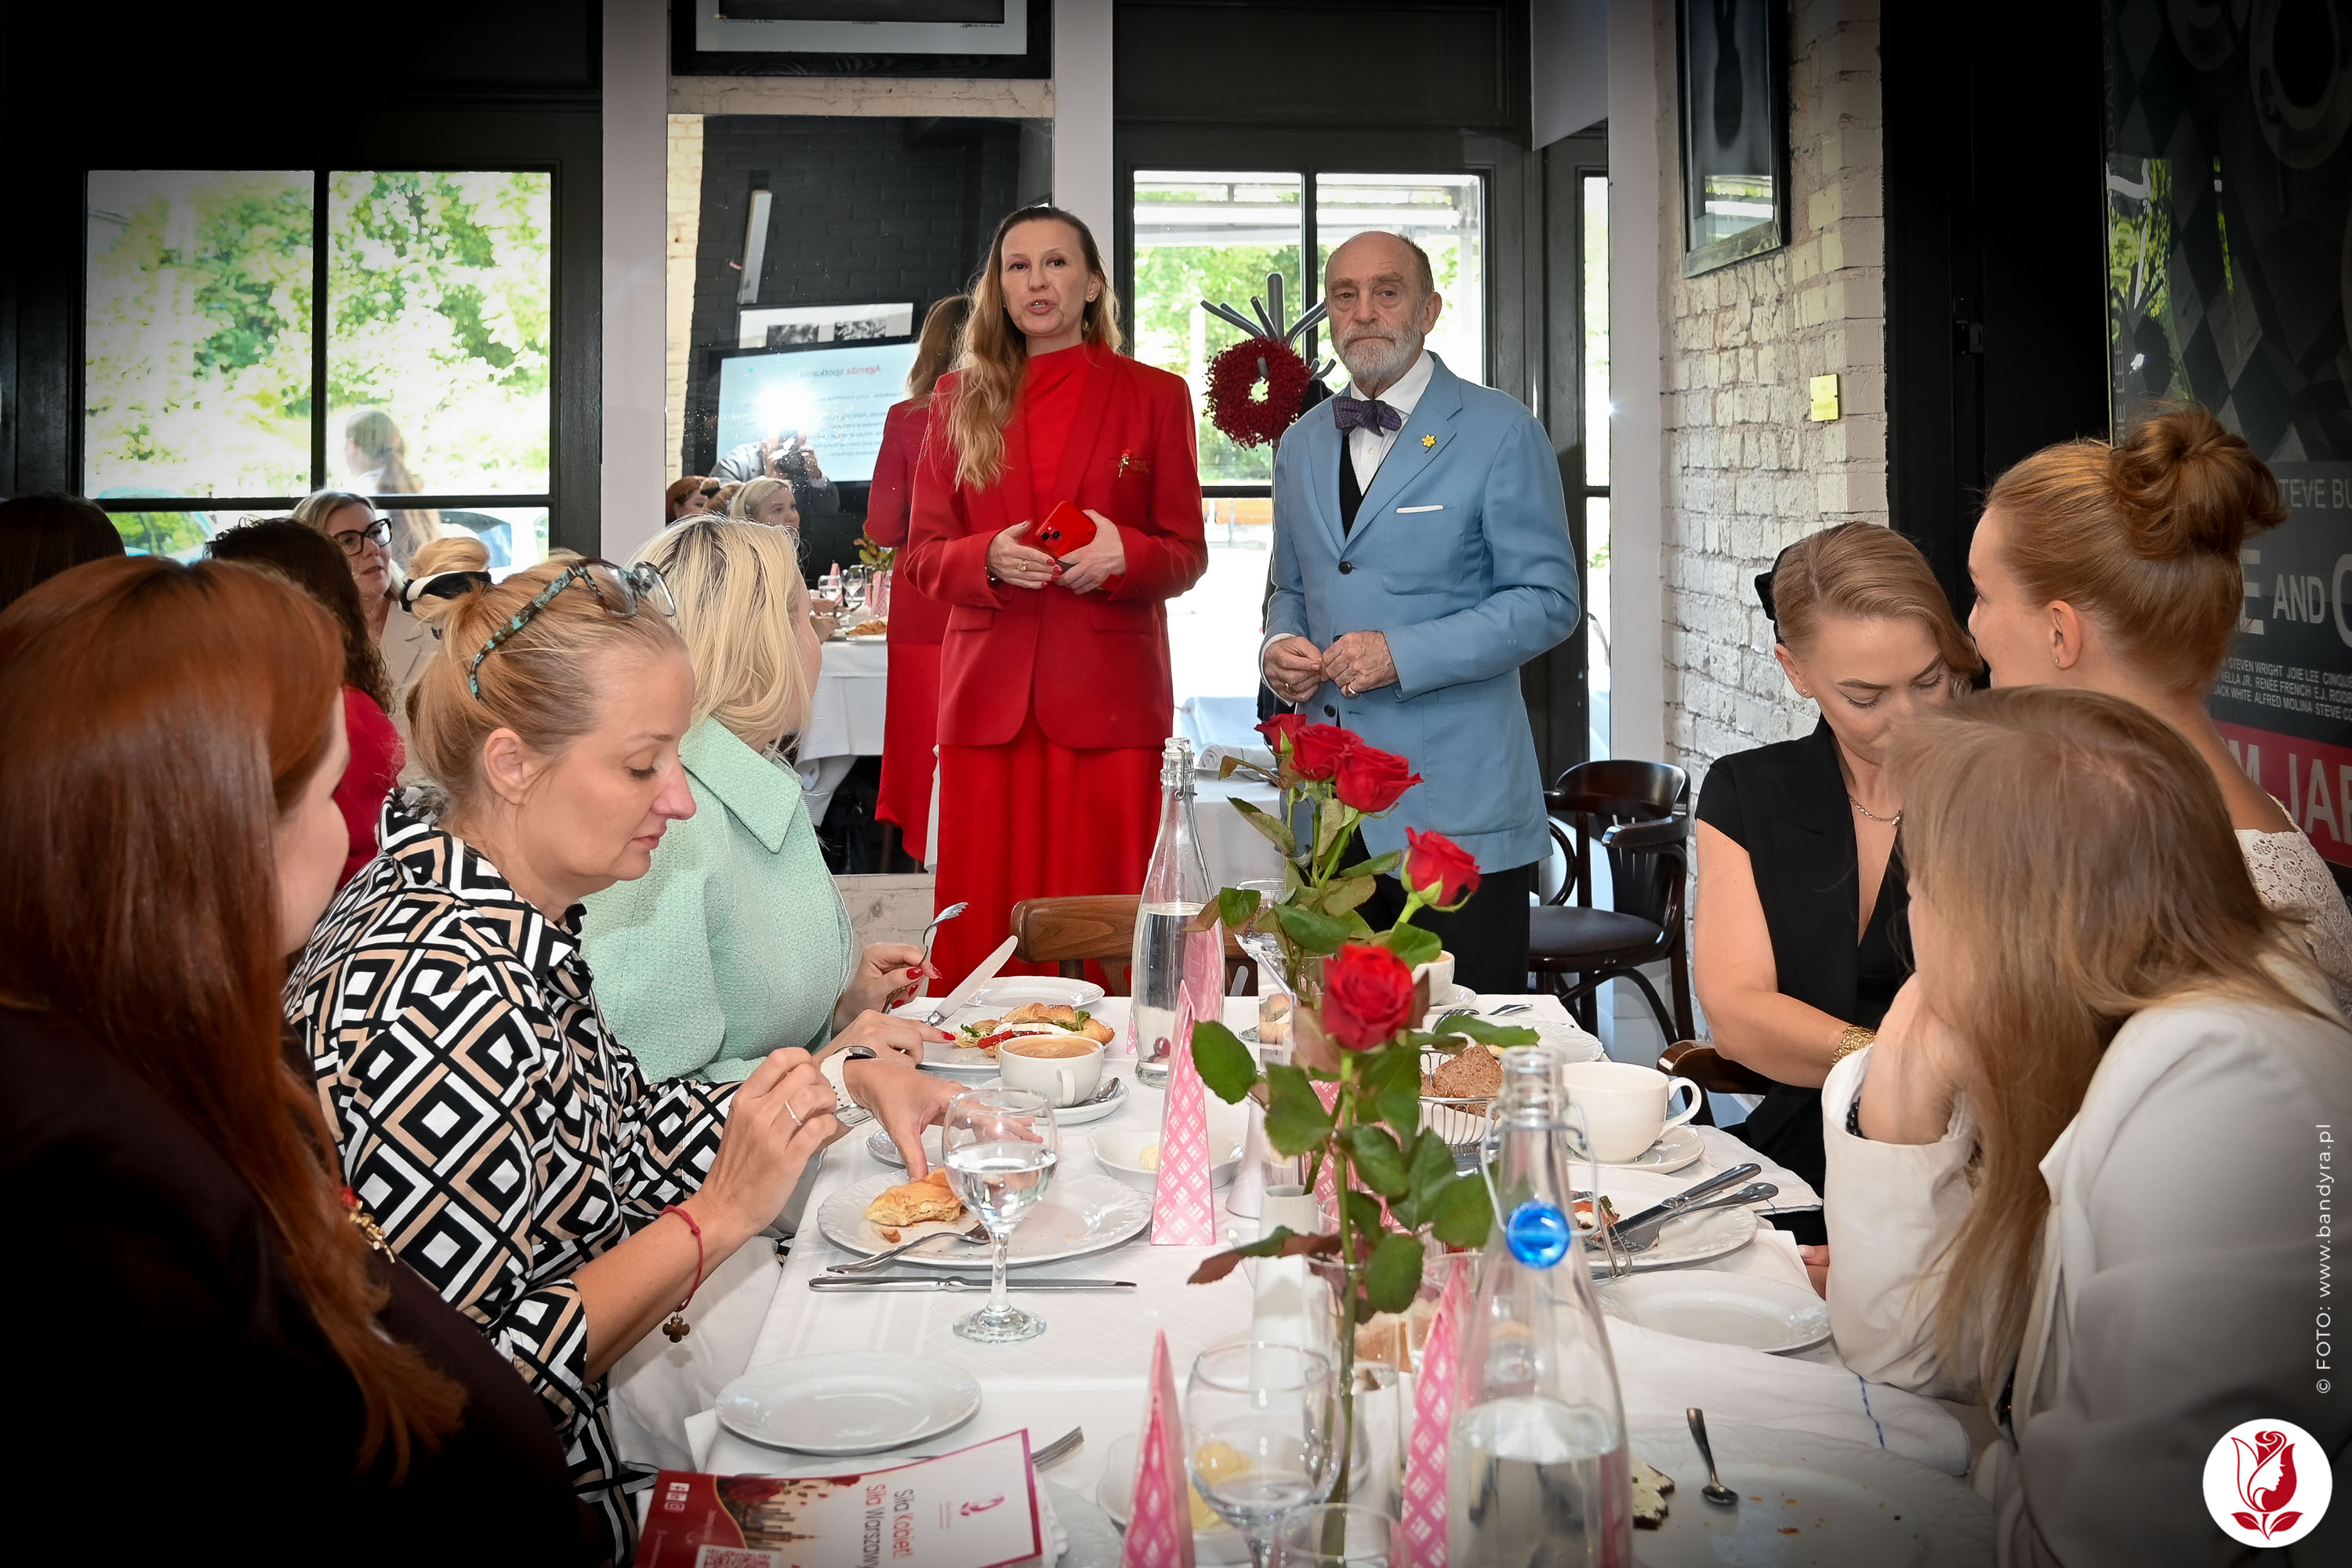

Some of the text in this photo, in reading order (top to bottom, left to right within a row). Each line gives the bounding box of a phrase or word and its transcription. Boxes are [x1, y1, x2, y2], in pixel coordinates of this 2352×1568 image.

[2278, 478, 2327, 509] TEVE
[2272, 573, 2325, 624] AND
[2228, 657, 2255, 673] STEVEN
[2255, 661, 2284, 677] WRIGHT
[2286, 666, 2304, 681] JOIE
[2305, 669, 2320, 683] LEE
[2213, 684, 2230, 698] JACK
[2230, 686, 2252, 702] WHITE
[2253, 691, 2281, 708] ALFRED
[2283, 696, 2313, 714] MOLINA
[2314, 702, 2342, 719] STEVE
[2255, 676, 2279, 692] RENÉE
[2279, 681, 2312, 698] FRENCH
